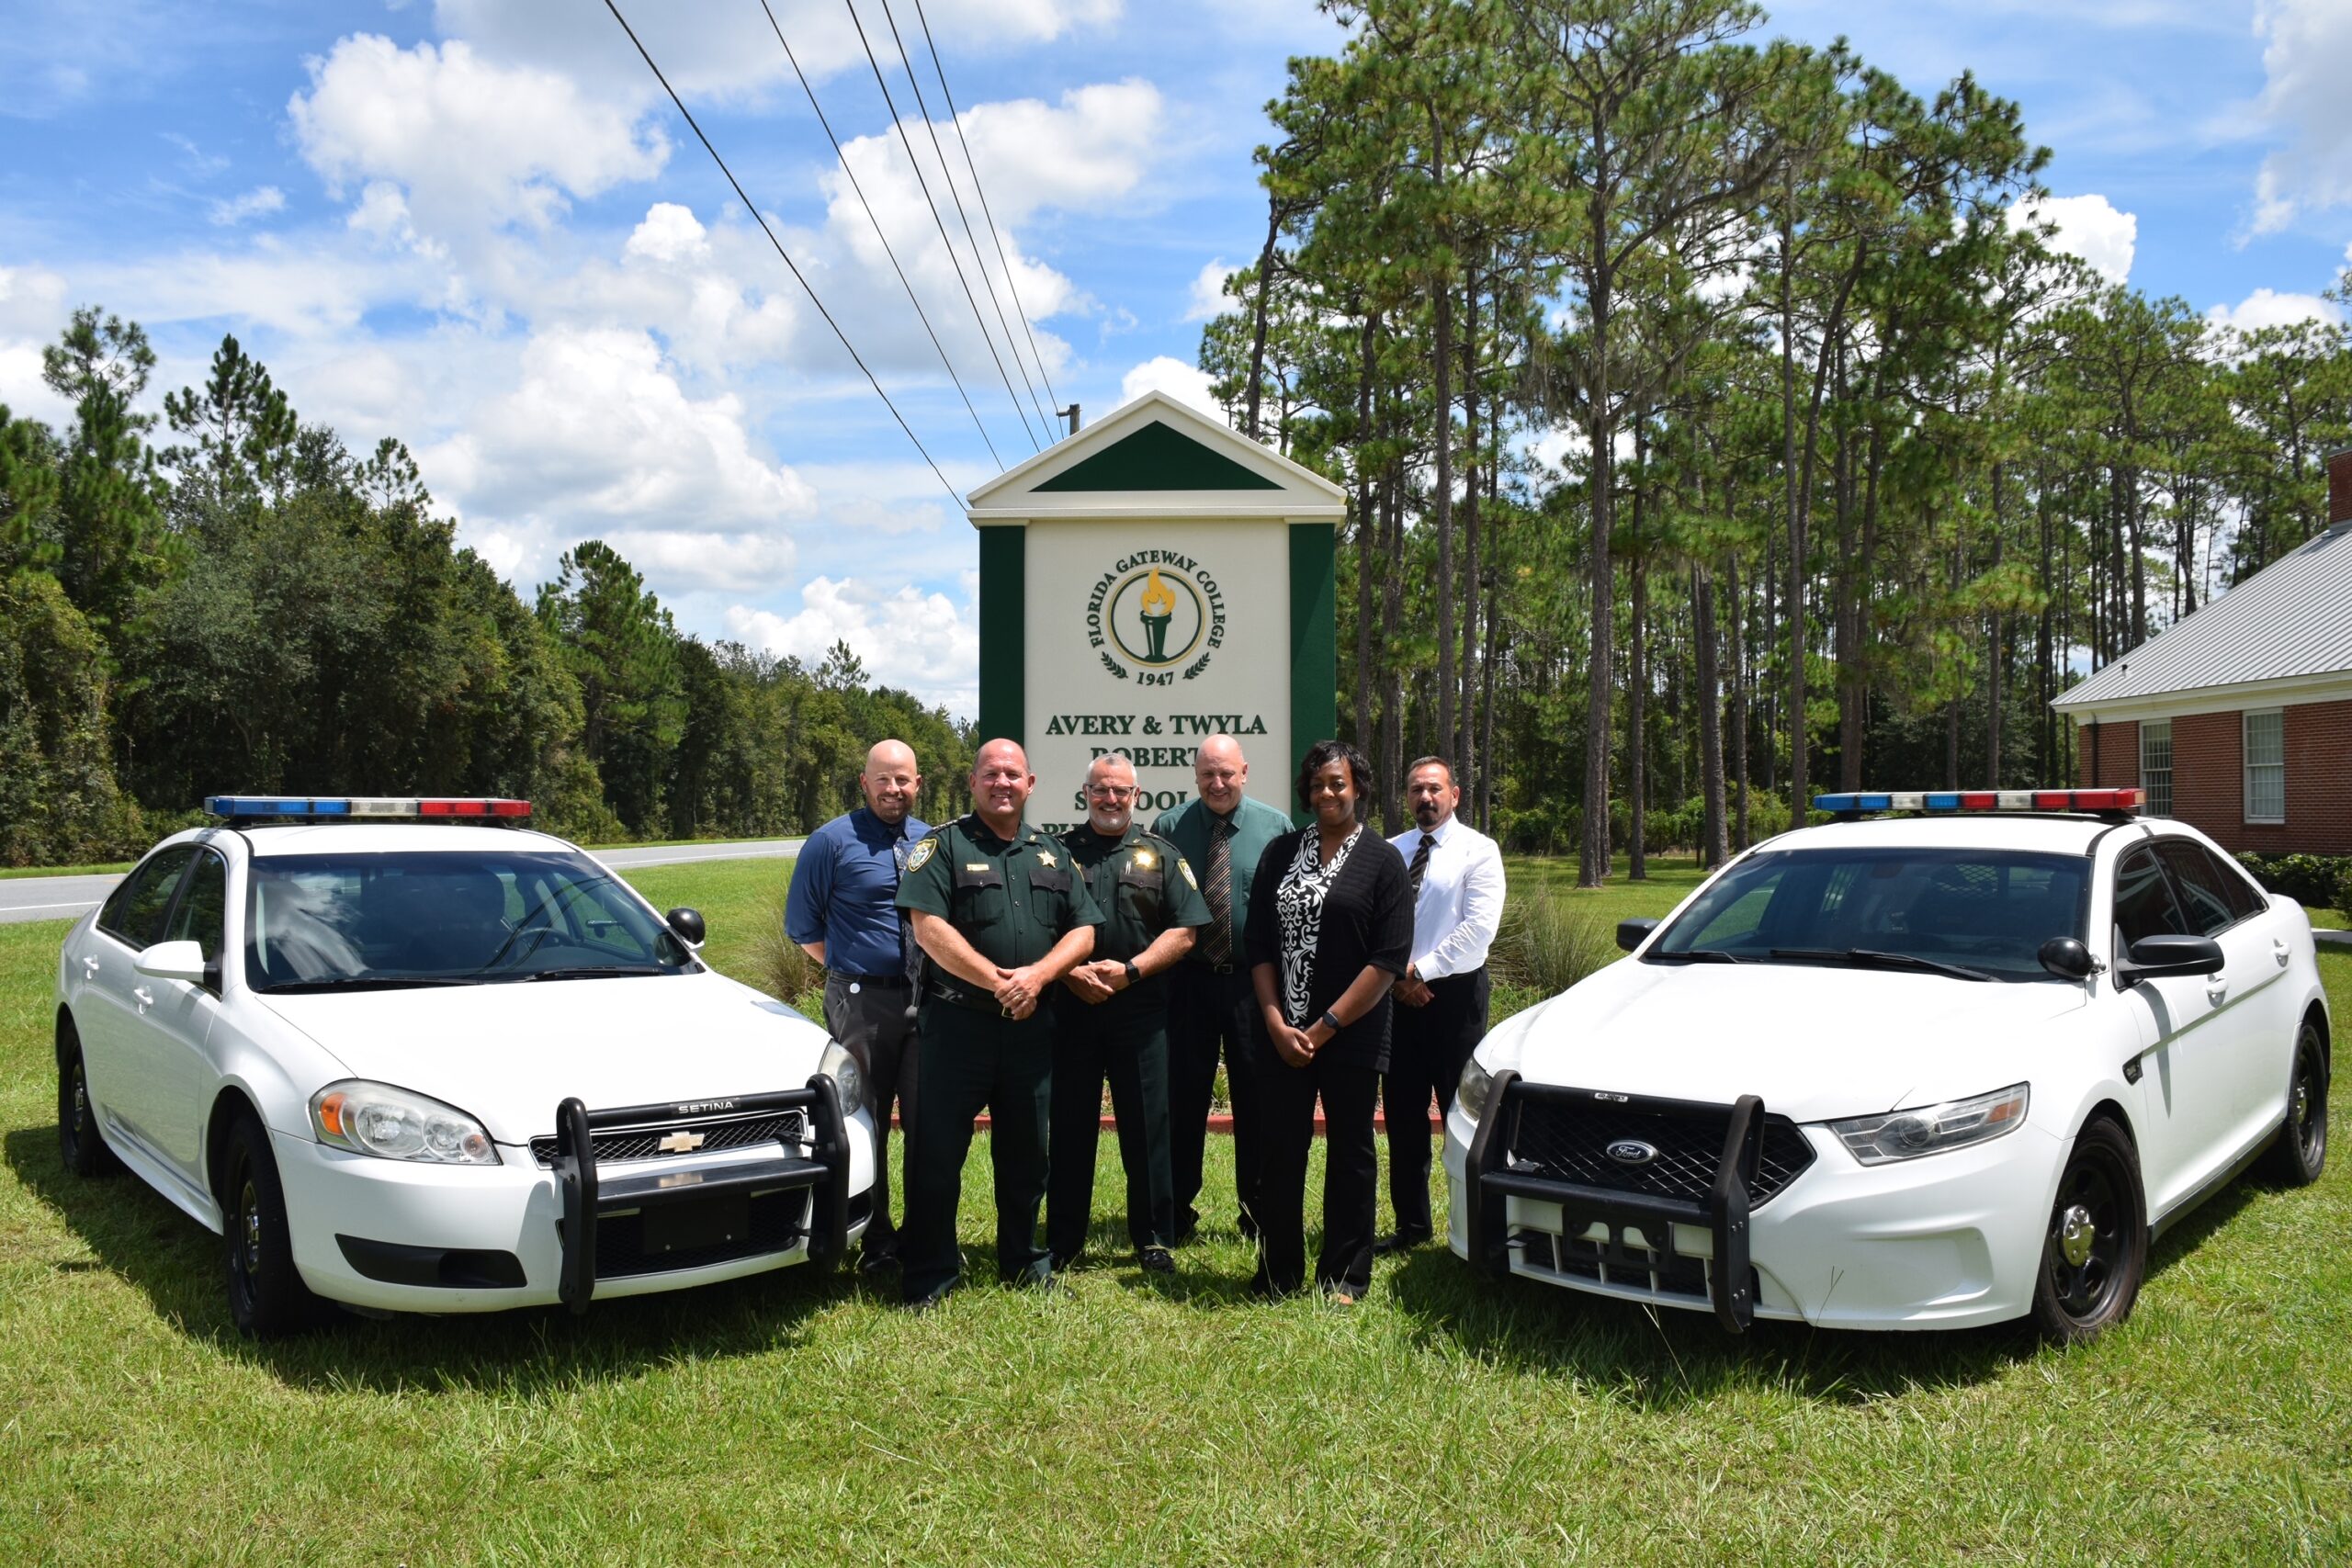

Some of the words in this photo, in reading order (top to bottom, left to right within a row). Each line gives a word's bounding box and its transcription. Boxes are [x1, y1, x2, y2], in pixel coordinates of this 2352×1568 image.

[1087, 572, 1117, 649] FLORIDA
[1115, 550, 1198, 573] GATEWAY
[1196, 570, 1226, 649] COLLEGE
[1136, 671, 1174, 686] 1947
[1046, 715, 1136, 735] AVERY
[1142, 716, 1162, 735] &
[1170, 715, 1268, 735] TWYLA
[1075, 791, 1187, 811] SOO
[678, 1101, 734, 1114] SETINA
[1616, 1145, 1641, 1158] Ford
